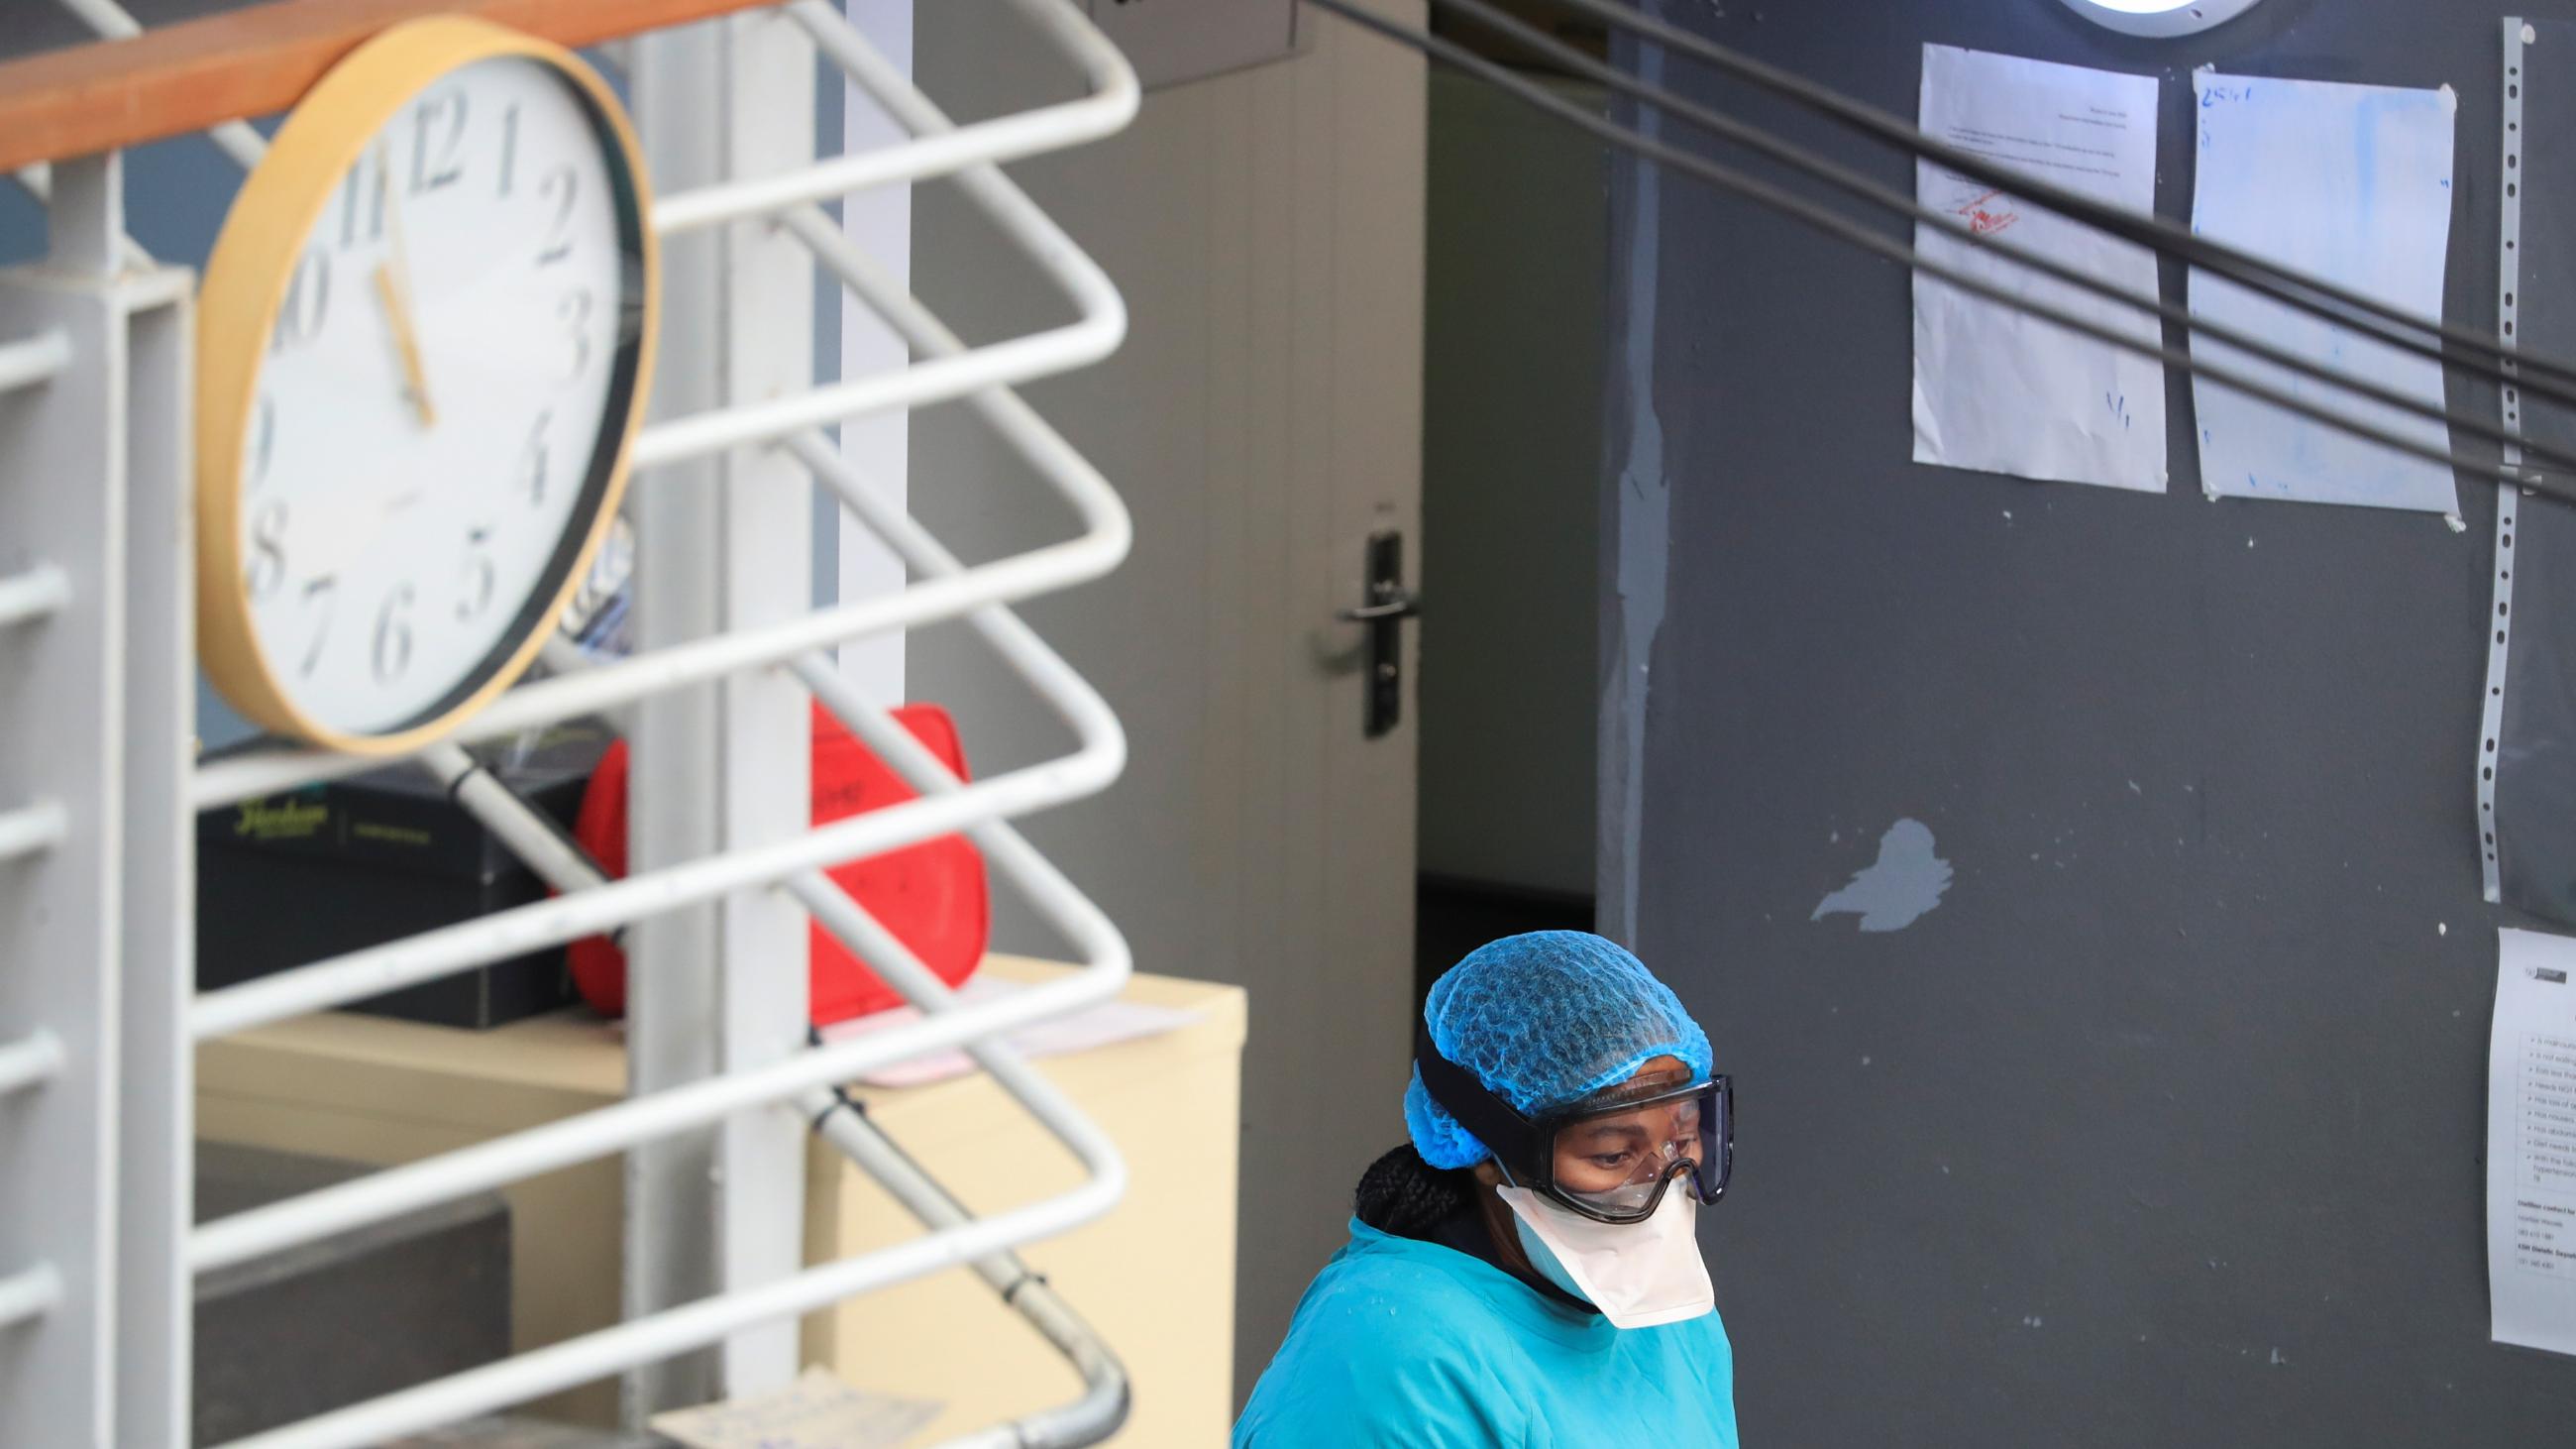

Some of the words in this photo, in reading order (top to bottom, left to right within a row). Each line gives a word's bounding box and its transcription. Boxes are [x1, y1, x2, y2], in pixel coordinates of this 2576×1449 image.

[408, 87, 468, 199] 12
[496, 100, 521, 200] 1
[534, 161, 579, 270] 2
[555, 285, 592, 392] 3
[514, 402, 554, 509] 4
[247, 496, 290, 604] 8
[455, 519, 499, 624] 5
[301, 569, 340, 683] 7
[370, 579, 417, 687] 6
